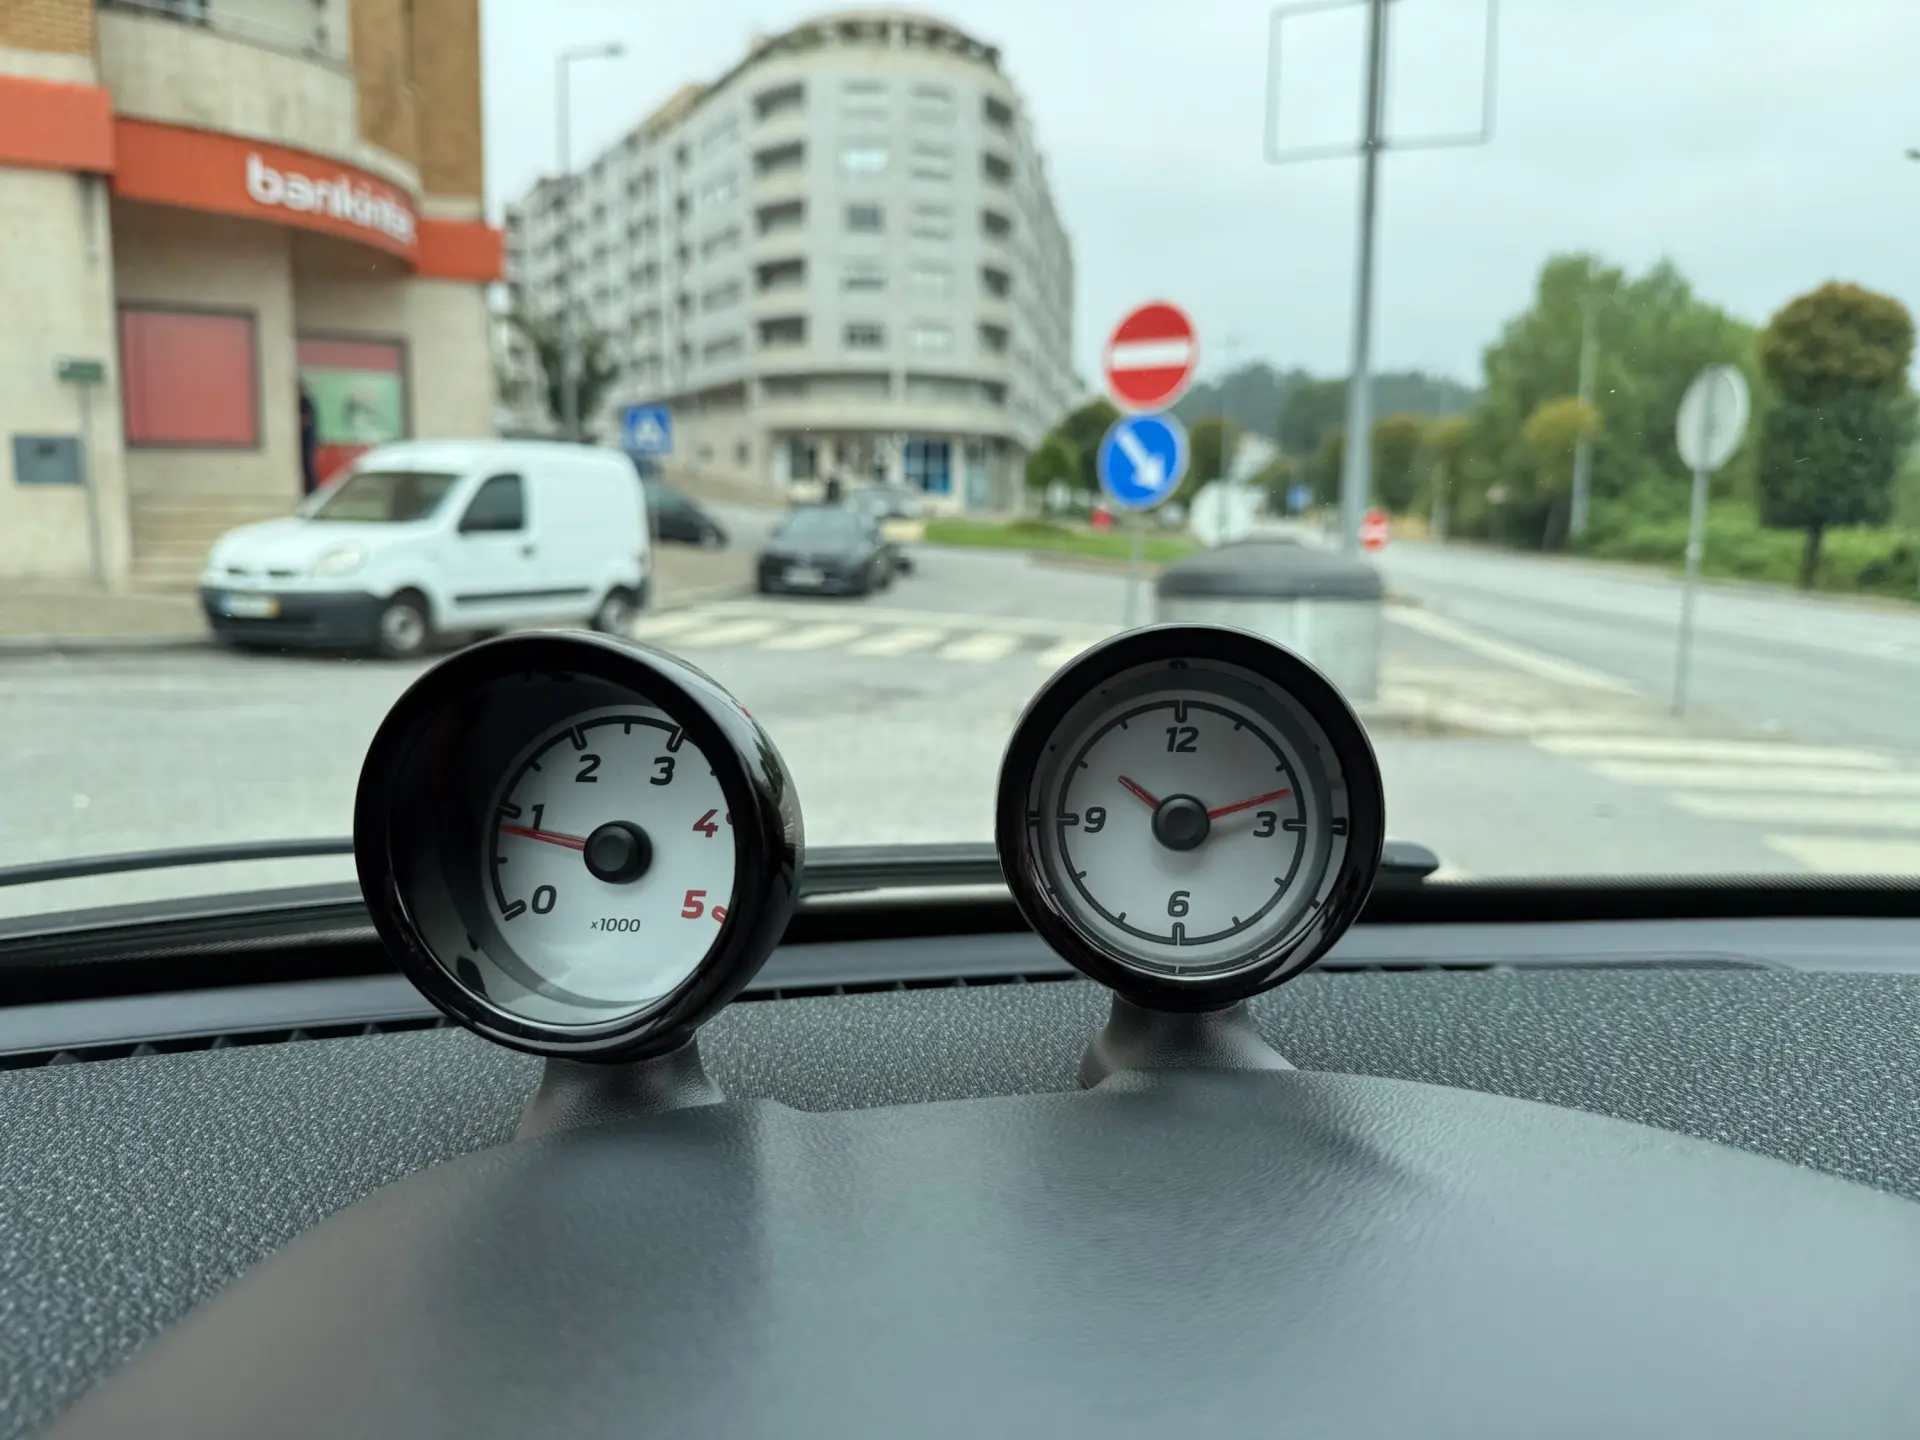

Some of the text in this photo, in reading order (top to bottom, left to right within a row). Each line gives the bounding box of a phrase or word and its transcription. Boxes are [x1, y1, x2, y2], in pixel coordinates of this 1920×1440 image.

[1165, 726, 1199, 753] 12
[575, 754, 602, 783] 2
[649, 756, 676, 786] 3
[531, 804, 545, 831] 1
[692, 809, 719, 838] 4
[1084, 806, 1107, 833] 9
[1253, 811, 1278, 838] 3
[531, 885, 557, 915] 0
[681, 889, 707, 919] 5
[1167, 890, 1191, 917] 6
[590, 918, 641, 933] x1000
